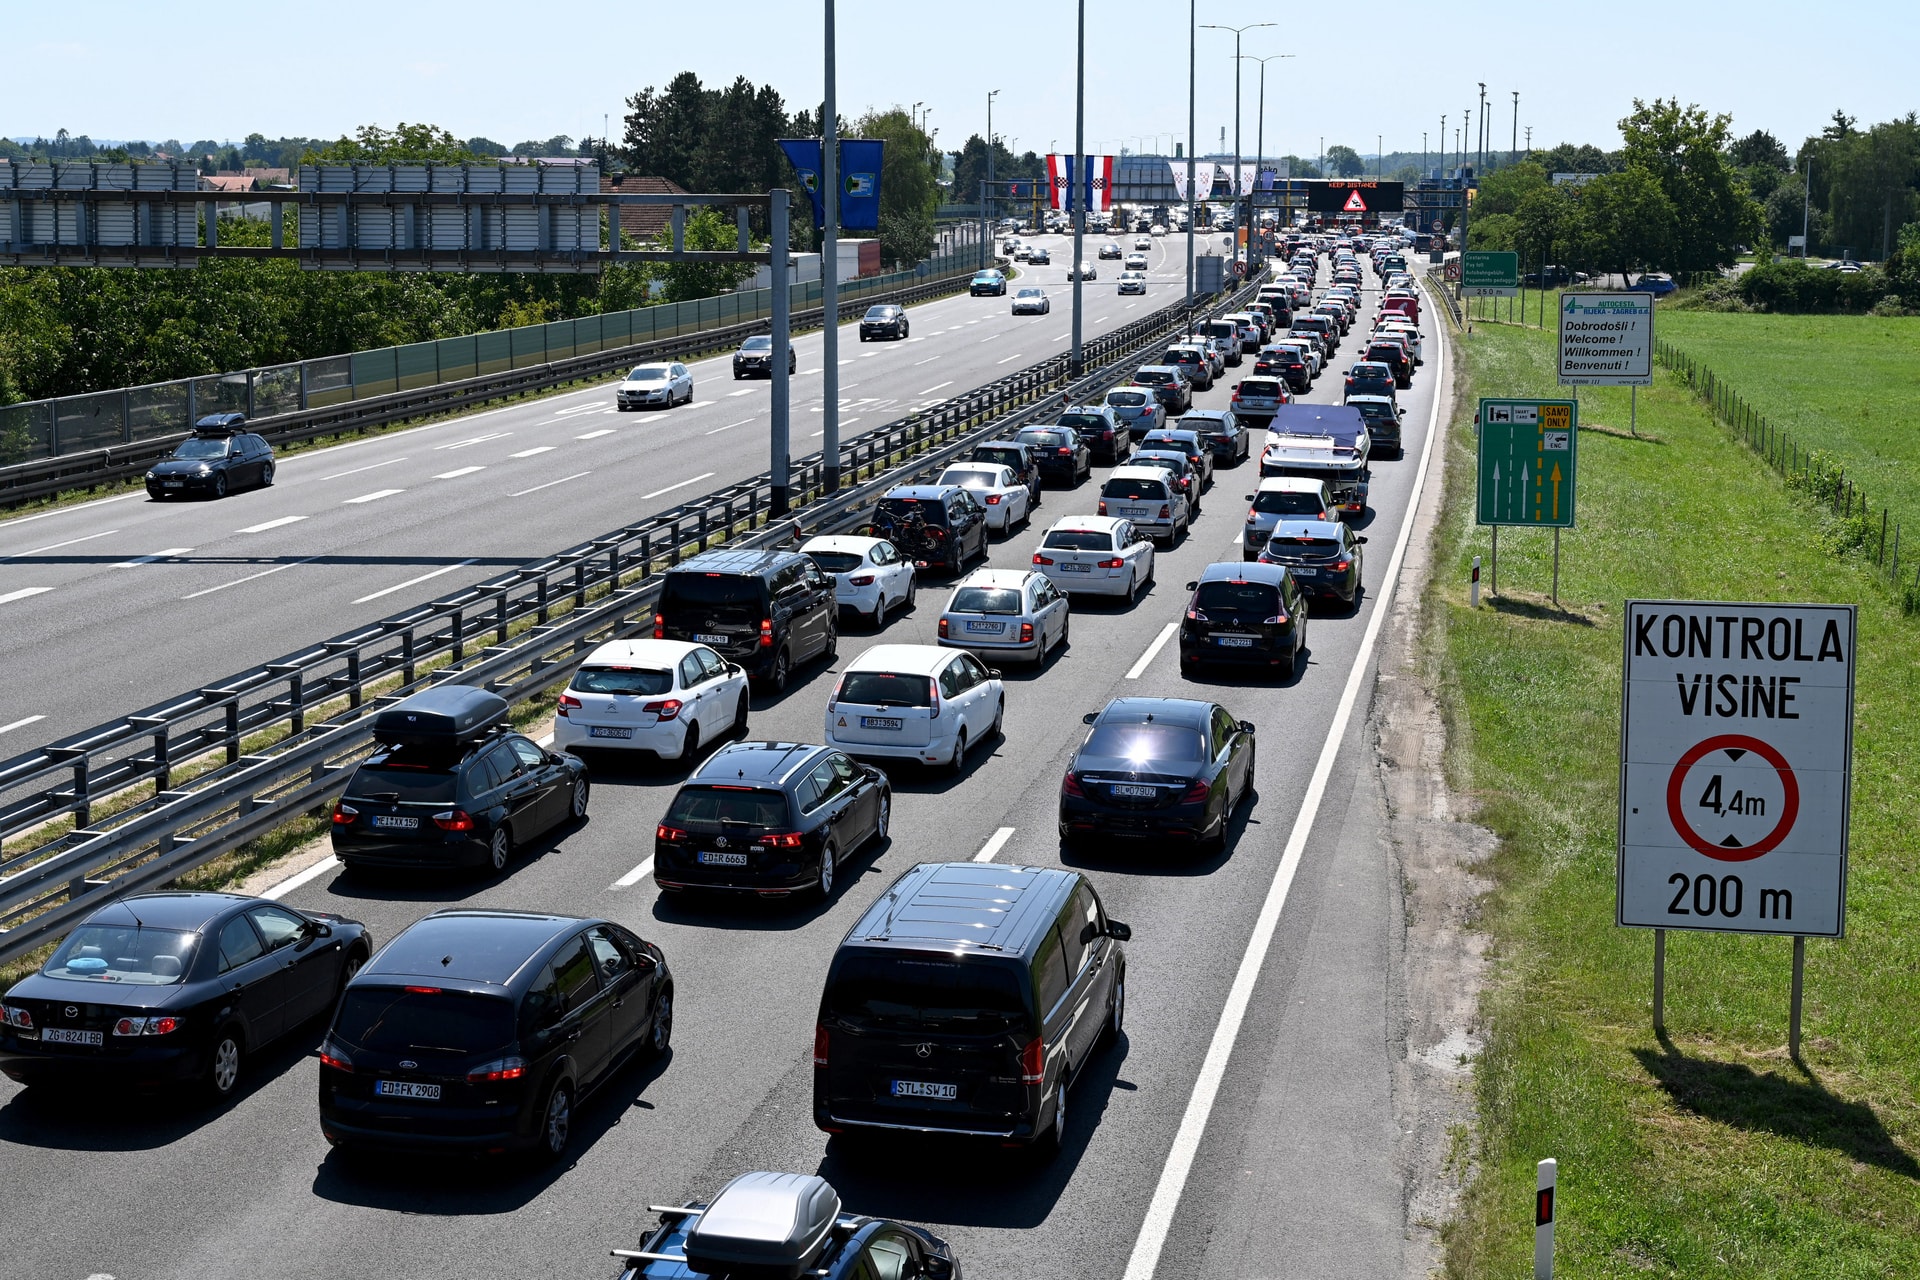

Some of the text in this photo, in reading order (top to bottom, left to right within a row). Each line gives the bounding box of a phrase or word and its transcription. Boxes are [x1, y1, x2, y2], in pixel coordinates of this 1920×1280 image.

[1565, 321, 1629, 331] Dobrodošli
[1565, 334, 1616, 344] Welcome
[1564, 347, 1634, 357] Willkommen
[1564, 360, 1622, 370] Benvenuti
[1545, 407, 1569, 417] SAMO
[1547, 418, 1567, 427] ONLY
[1634, 613, 1844, 663] KONTROLA
[1676, 672, 1801, 720] VISINE
[404, 818, 418, 827] 159
[725, 855, 746, 864] 6663
[1667, 872, 1794, 921] 200 m
[48, 1029, 60, 1041] ZG
[381, 1081, 440, 1098] ED FK 2908
[896, 1081, 957, 1098] STL SW 10
